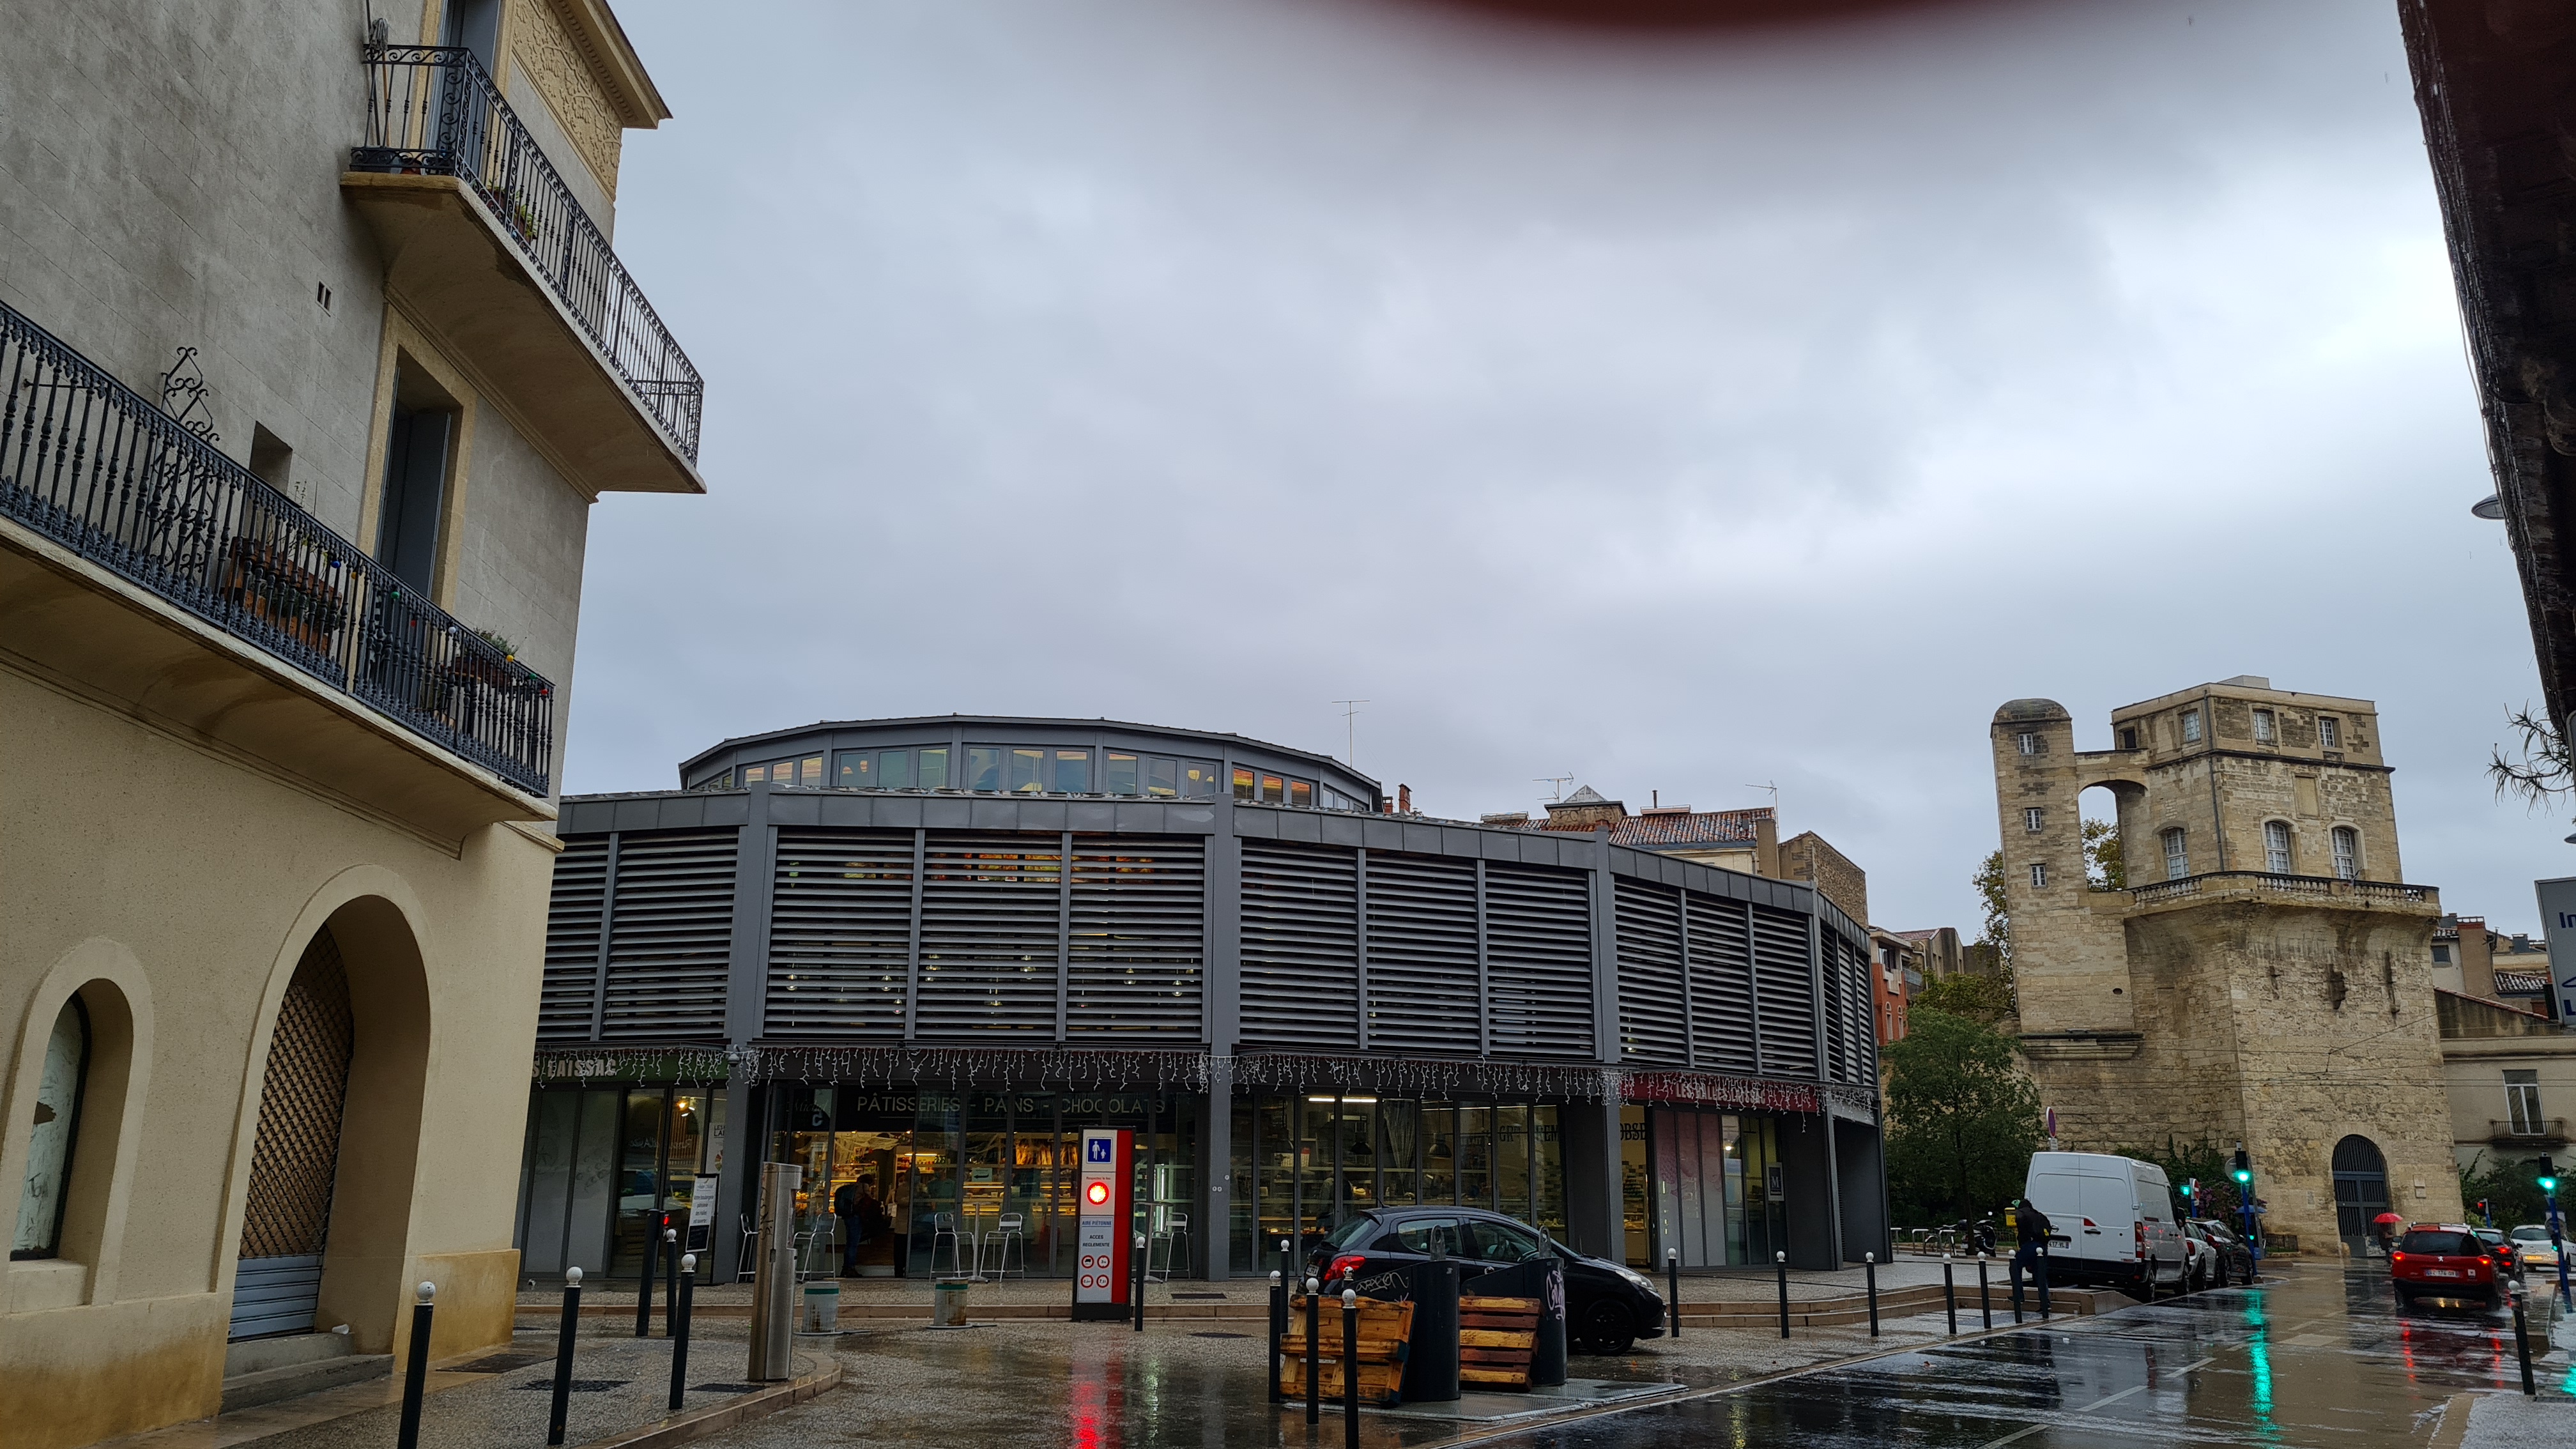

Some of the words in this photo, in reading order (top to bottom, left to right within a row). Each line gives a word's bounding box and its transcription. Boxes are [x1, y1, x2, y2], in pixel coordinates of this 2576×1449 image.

[548, 1059, 617, 1077] LAISSAC
[1676, 1083, 1692, 1098] LES
[857, 1092, 960, 1112] PÂTISSERIES
[985, 1097, 1034, 1112] PANS
